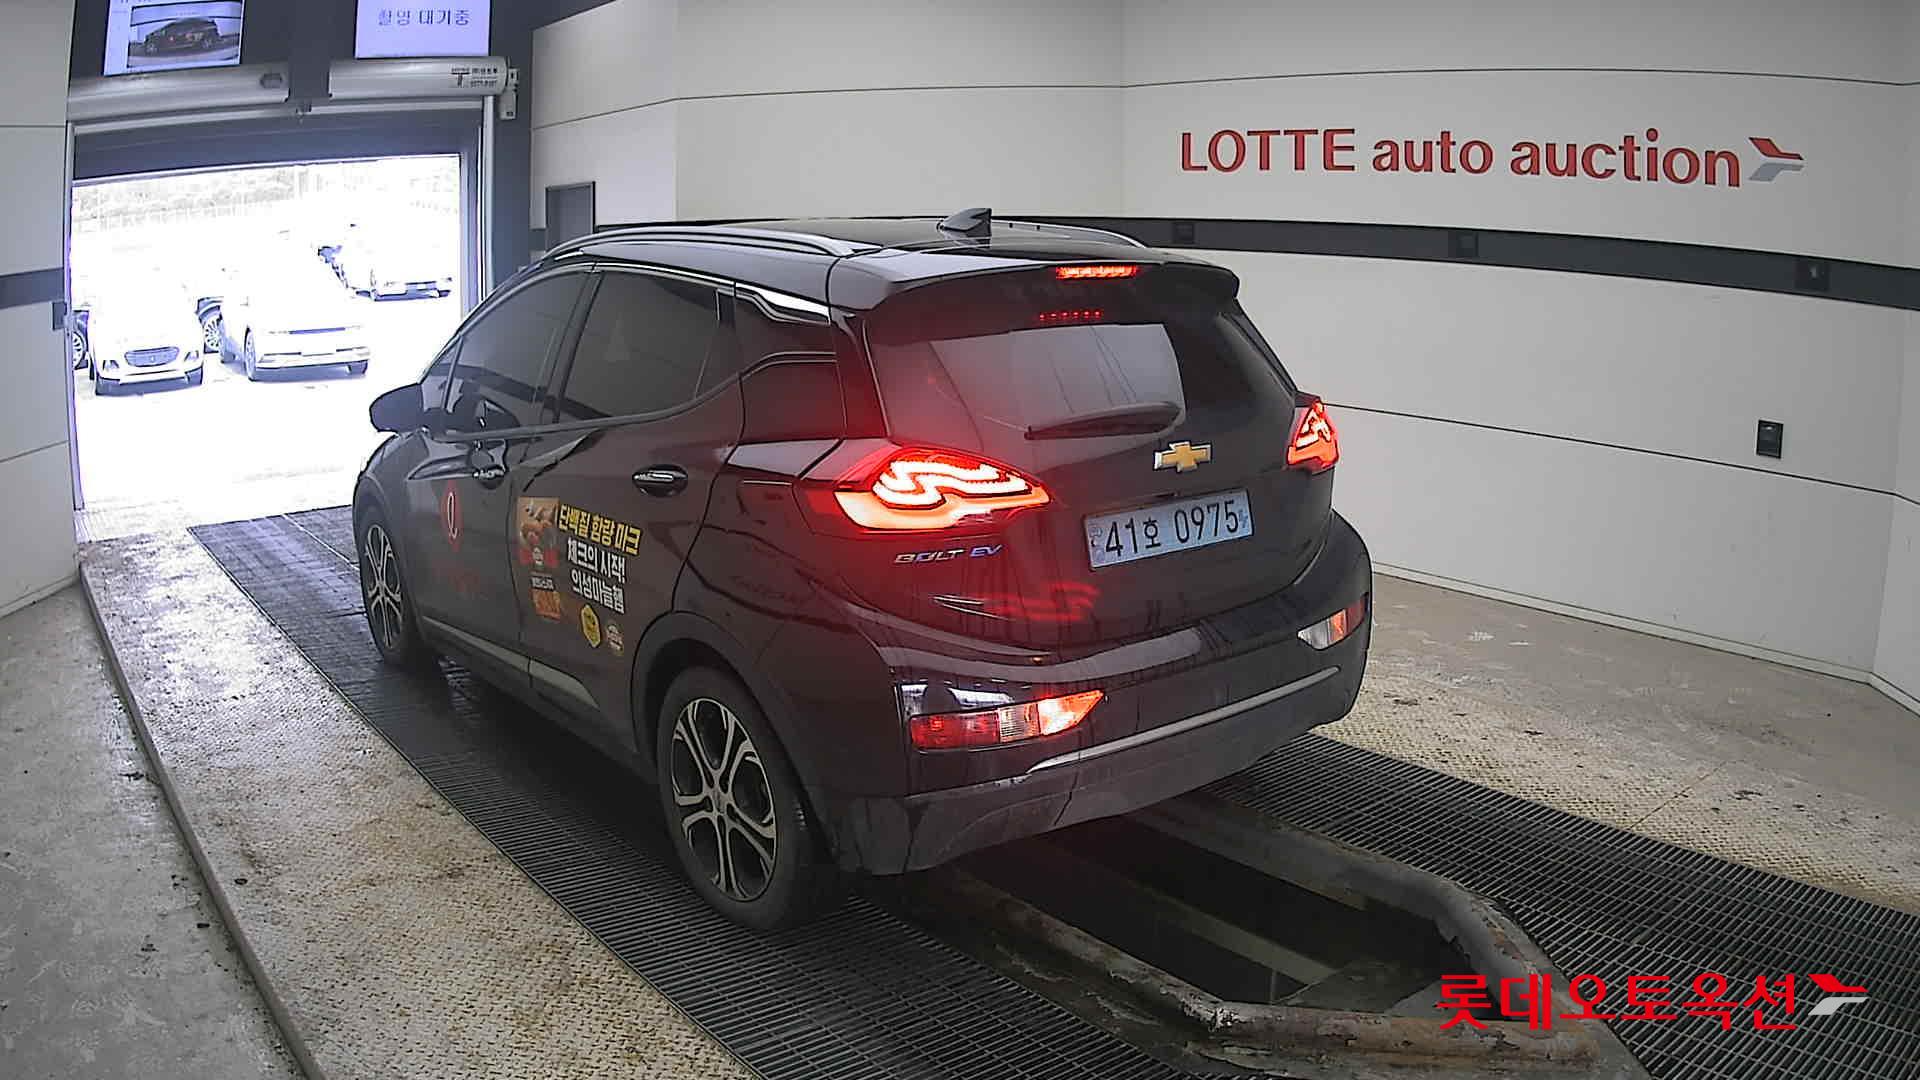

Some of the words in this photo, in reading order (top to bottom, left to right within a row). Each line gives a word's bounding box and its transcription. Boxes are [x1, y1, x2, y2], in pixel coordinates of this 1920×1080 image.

[418, 9, 470, 26] 대기중
[1180, 128, 1356, 173] LOTTE
[1372, 131, 1495, 174] auto
[1510, 127, 1741, 188] auction
[558, 503, 591, 539] 단백질
[591, 514, 616, 547] 함량
[1104, 516, 1162, 558] 41호
[1173, 499, 1240, 544] 0975
[567, 536, 599, 574] 체크의
[600, 550, 626, 585] 시작!
[893, 549, 965, 564] BOLT
[969, 544, 1004, 558] EV
[570, 568, 626, 615] 의성마늘햄
